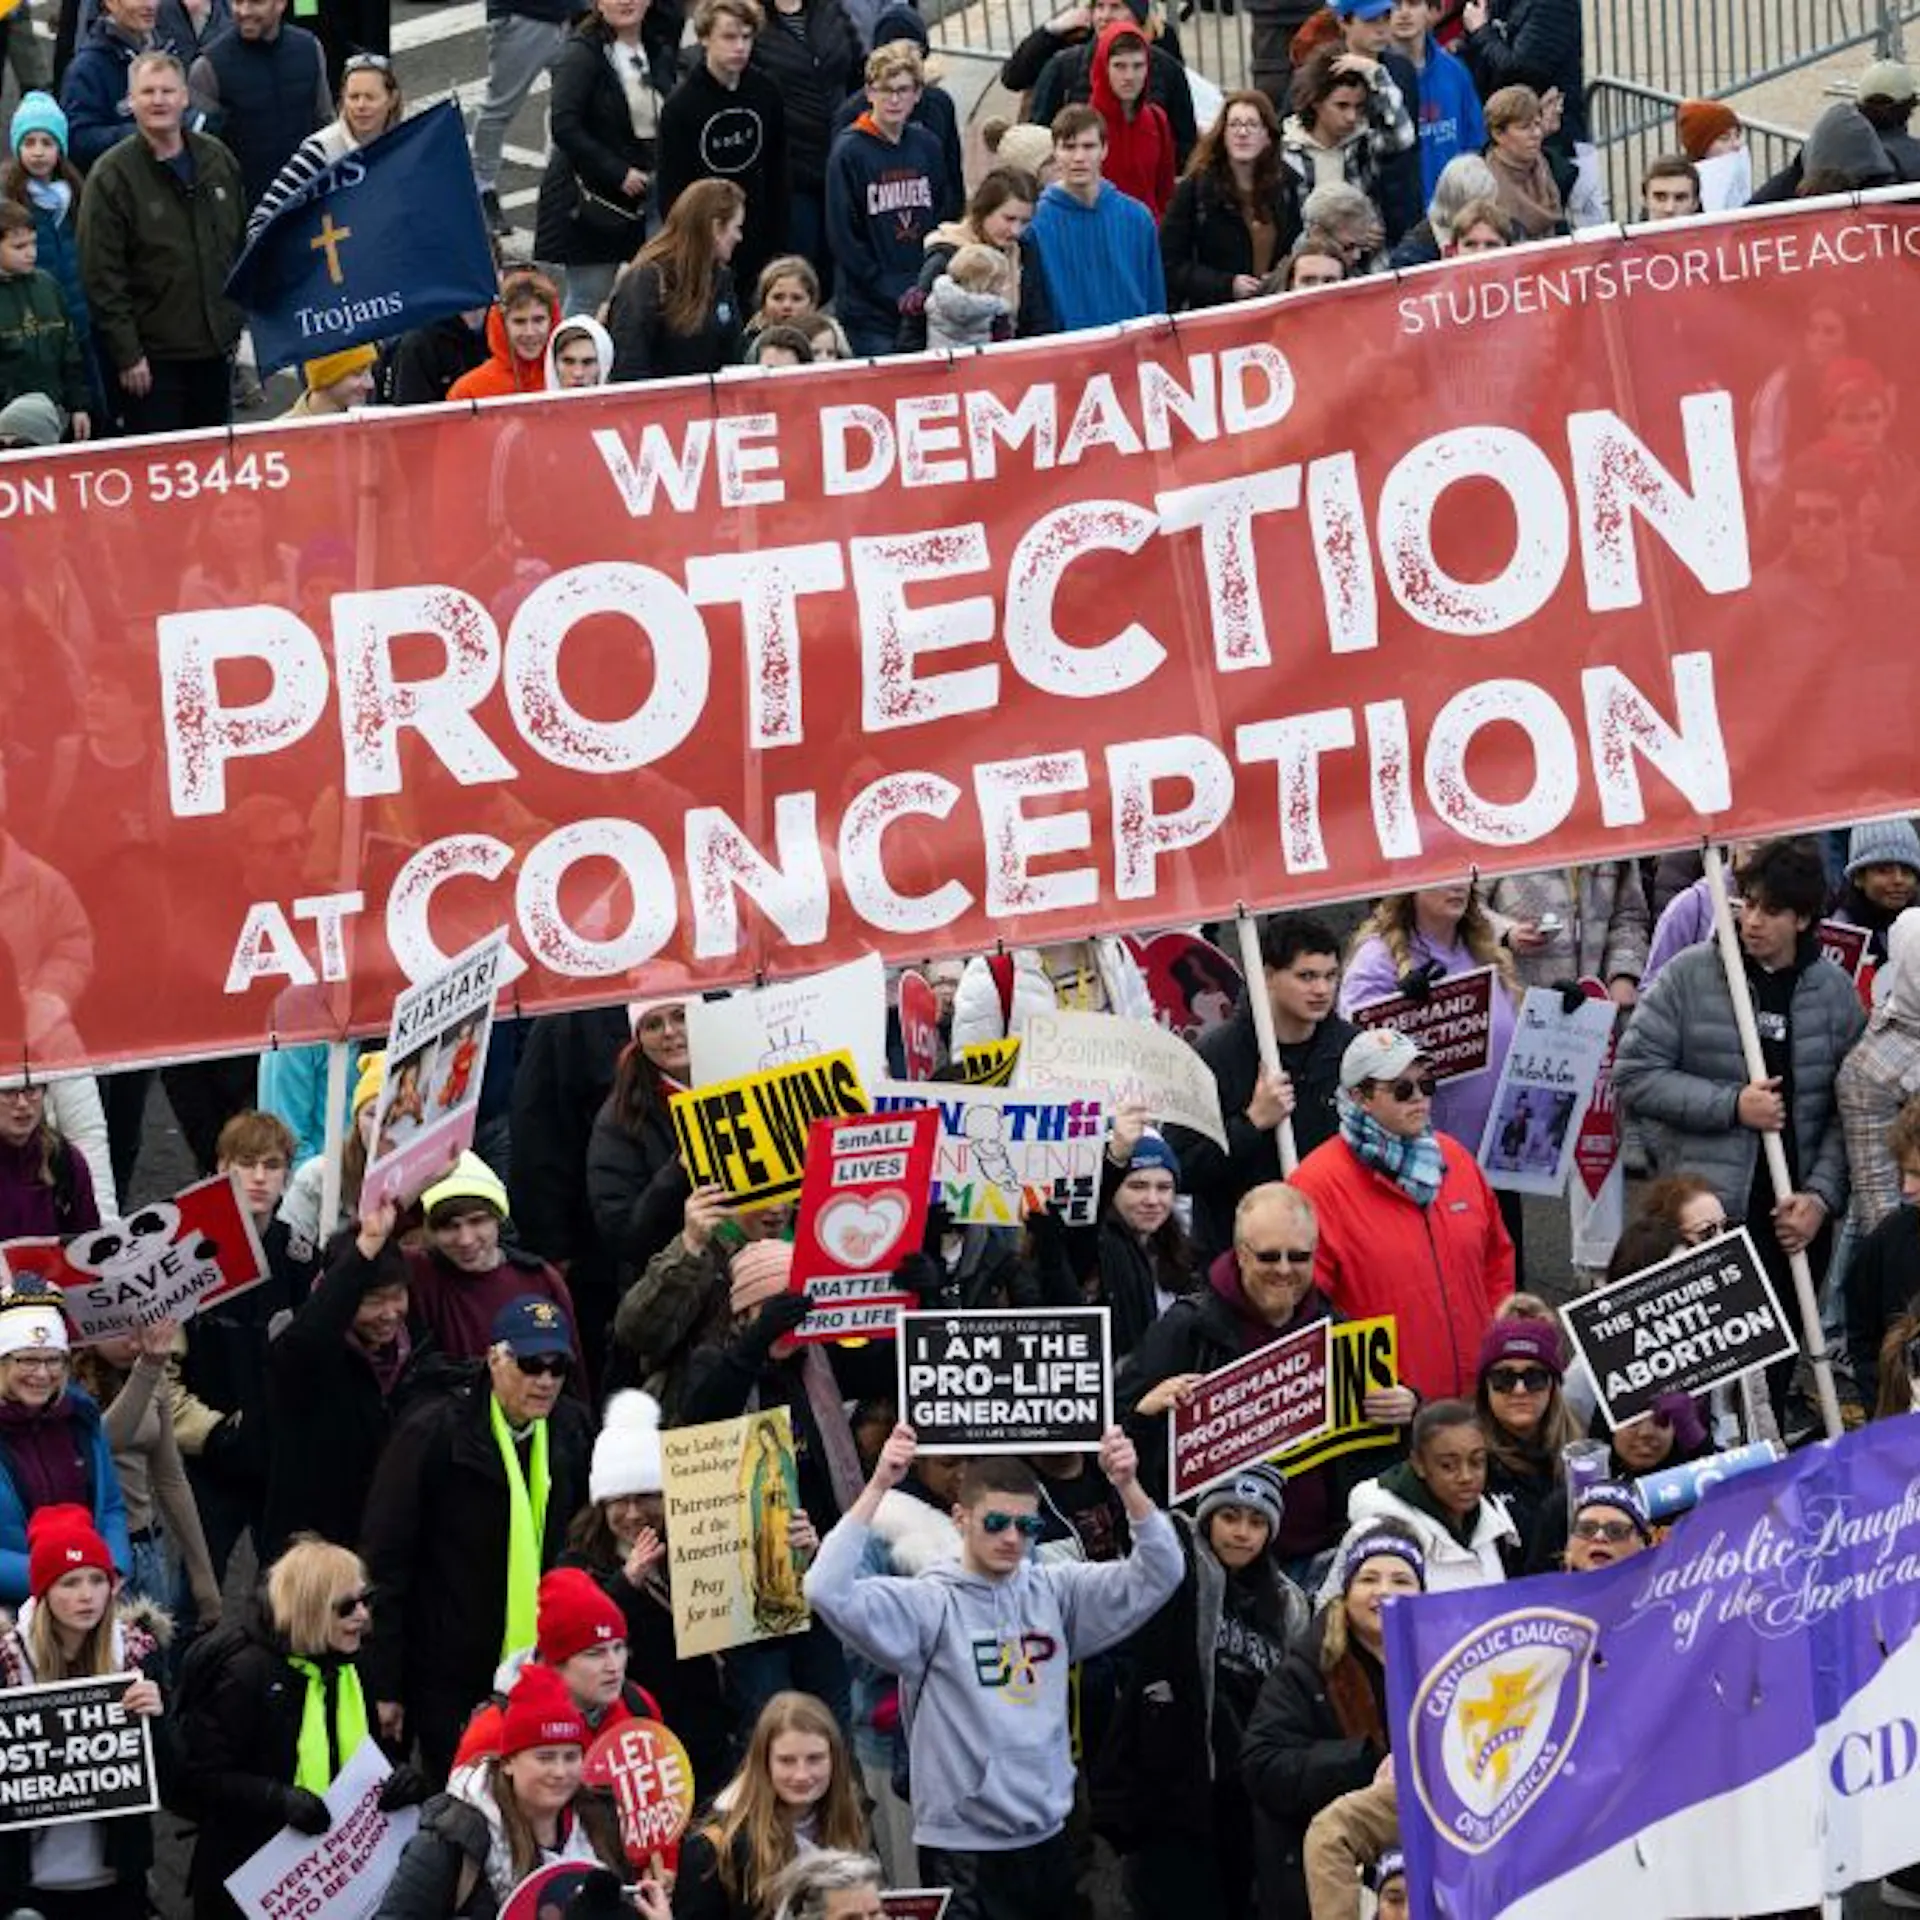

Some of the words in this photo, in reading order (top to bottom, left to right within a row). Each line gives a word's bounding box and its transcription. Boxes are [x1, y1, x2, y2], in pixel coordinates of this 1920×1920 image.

[294, 290, 404, 337] Trojans
[592, 412, 785, 517] WE
[820, 342, 1295, 497] DEMAND
[70, 468, 132, 510] TO
[147, 451, 290, 502] 53445
[156, 390, 1752, 817] PROTECTION
[223, 892, 365, 994] AT
[386, 651, 1733, 989] CONCEPTION
[1381, 994, 1478, 1031] DEMAND
[674, 1090, 770, 1192] LIFE
[837, 1157, 901, 1182] LIVES
[81, 1314, 135, 1337] BABY
[141, 1266, 218, 1329] HUMANS
[87, 1249, 185, 1309] SAVE
[1589, 1310, 1635, 1342] THE
[1635, 1274, 1719, 1323] FUTURE
[1718, 1262, 1743, 1287] IS
[802, 1312, 844, 1331] PRO
[851, 1307, 898, 1327] LIFE
[917, 1336, 929, 1361] I
[945, 1335, 1002, 1360] AM
[1016, 1334, 1090, 1360] THE
[1633, 1302, 1723, 1357] ANTI-
[908, 1361, 1101, 1397] PRO-LIFE
[1605, 1304, 1777, 1401] ABORTION
[913, 1398, 1098, 1427] GENERATION
[1176, 1366, 1326, 1457] PROTECTION
[1192, 1403, 1202, 1421] I
[1209, 1352, 1312, 1413] DEMAND
[665, 1441, 690, 1458] Our
[692, 1436, 726, 1456] Lady
[1181, 1450, 1209, 1478] AT
[1207, 1395, 1324, 1460] CONCEPTION
[670, 1490, 747, 1518] Patroness
[690, 1519, 705, 1537] of
[709, 1516, 731, 1533] the
[673, 1536, 749, 1565] Americas
[690, 1576, 726, 1599] Pray
[1673, 1587, 1715, 1654] of
[1718, 1577, 1766, 1624] the
[685, 1602, 707, 1632] for
[1426, 1630, 1510, 1719] CATHOLIC
[57, 1701, 129, 1731] THE
[0, 1727, 142, 1774] ST-ROE
[605, 1729, 657, 1778] LET
[1830, 1717, 1918, 1797] CD
[0, 1763, 143, 1806] NERATION
[260, 1850, 321, 1910] EVERY
[322, 1777, 387, 1854] PERSON
[292, 1897, 321, 1920] TO
[322, 1871, 350, 1899] BE
[351, 1815, 390, 1875] BORN
[271, 1884, 312, 1920] HAS
[311, 1849, 351, 1885] THE
